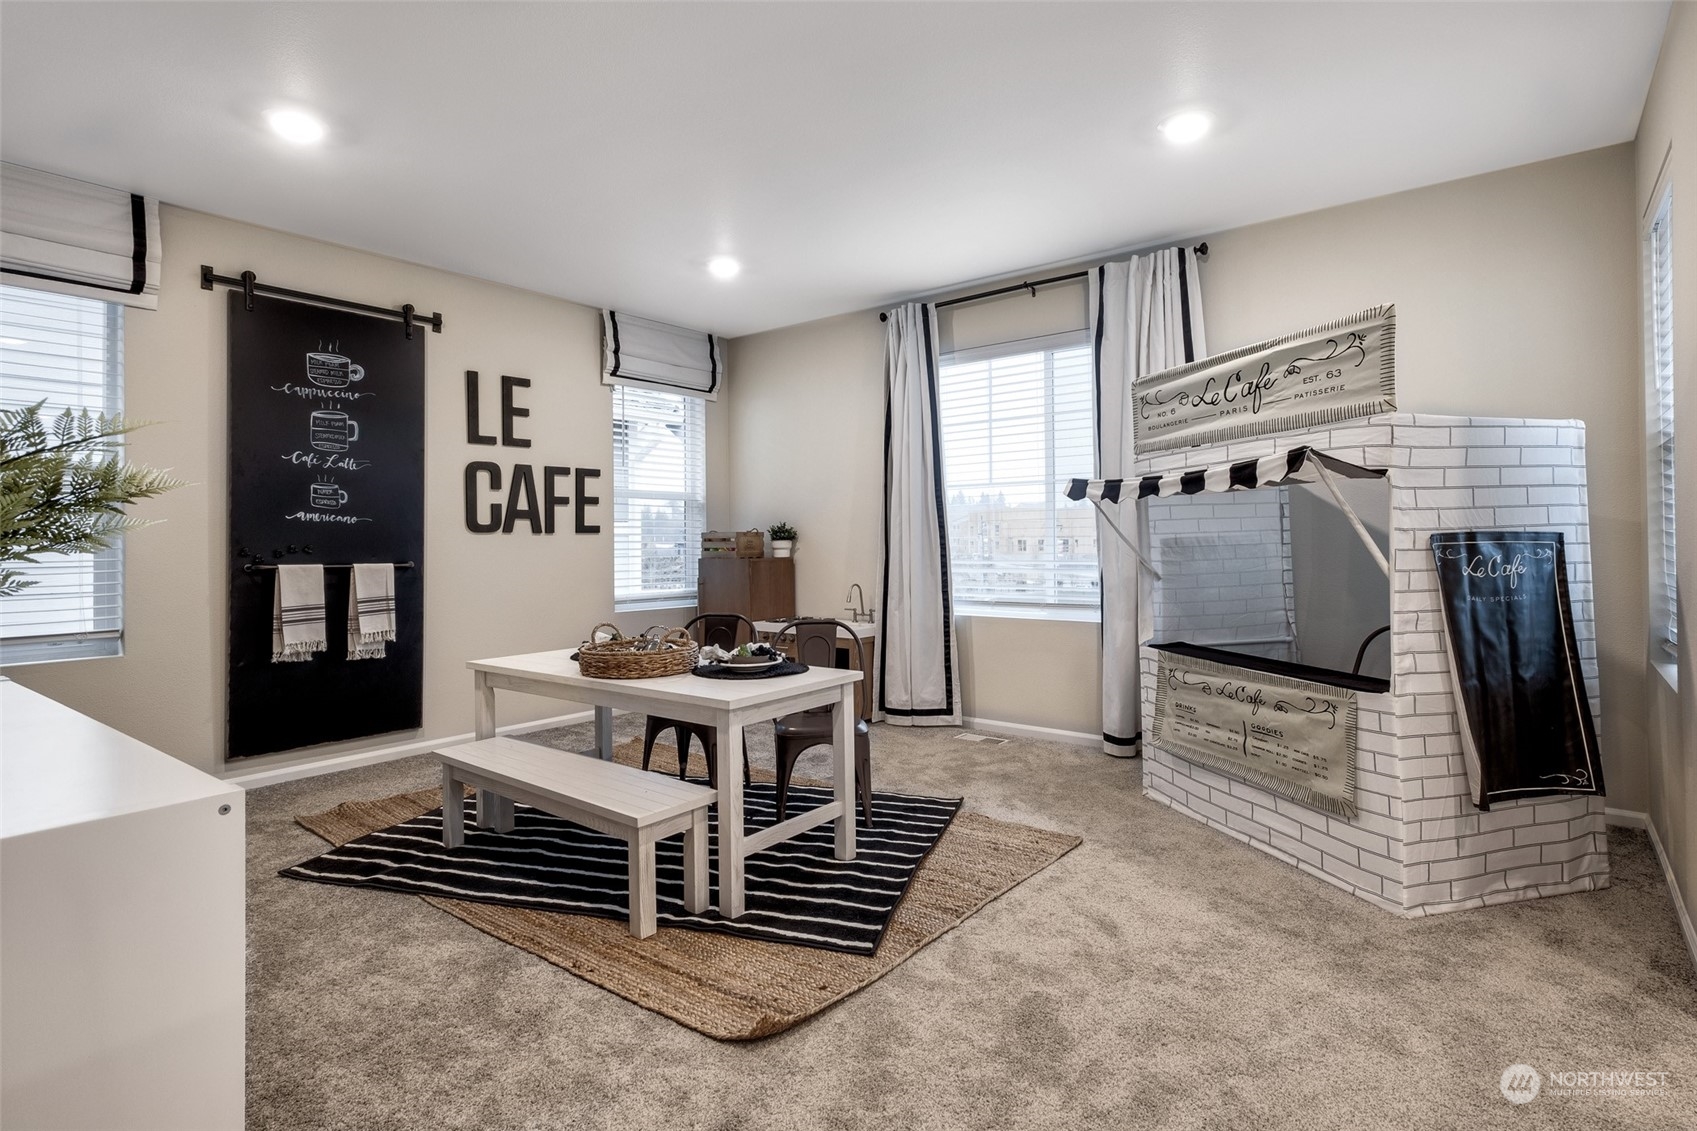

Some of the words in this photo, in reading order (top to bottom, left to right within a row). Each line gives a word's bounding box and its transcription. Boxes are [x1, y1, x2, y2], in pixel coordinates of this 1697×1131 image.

[1302, 373, 1323, 385] EST.
[1326, 368, 1343, 380] 63
[1191, 377, 1223, 408] Le
[466, 370, 532, 448] LE
[1148, 418, 1189, 432] BOULANGERIE
[1219, 405, 1248, 417] PARIS
[1293, 384, 1346, 400] PATISSERIE
[1156, 409, 1169, 419] NO.
[1169, 407, 1176, 416] 6
[465, 460, 602, 535] CAFE
[1462, 555, 1486, 578] Le
[1466, 594, 1487, 602] DAILY
[1489, 593, 1528, 603] SPECIALS
[1216, 682, 1235, 700] Le
[1174, 701, 1197, 713] DRINKS
[1250, 722, 1284, 738] GOODIES
